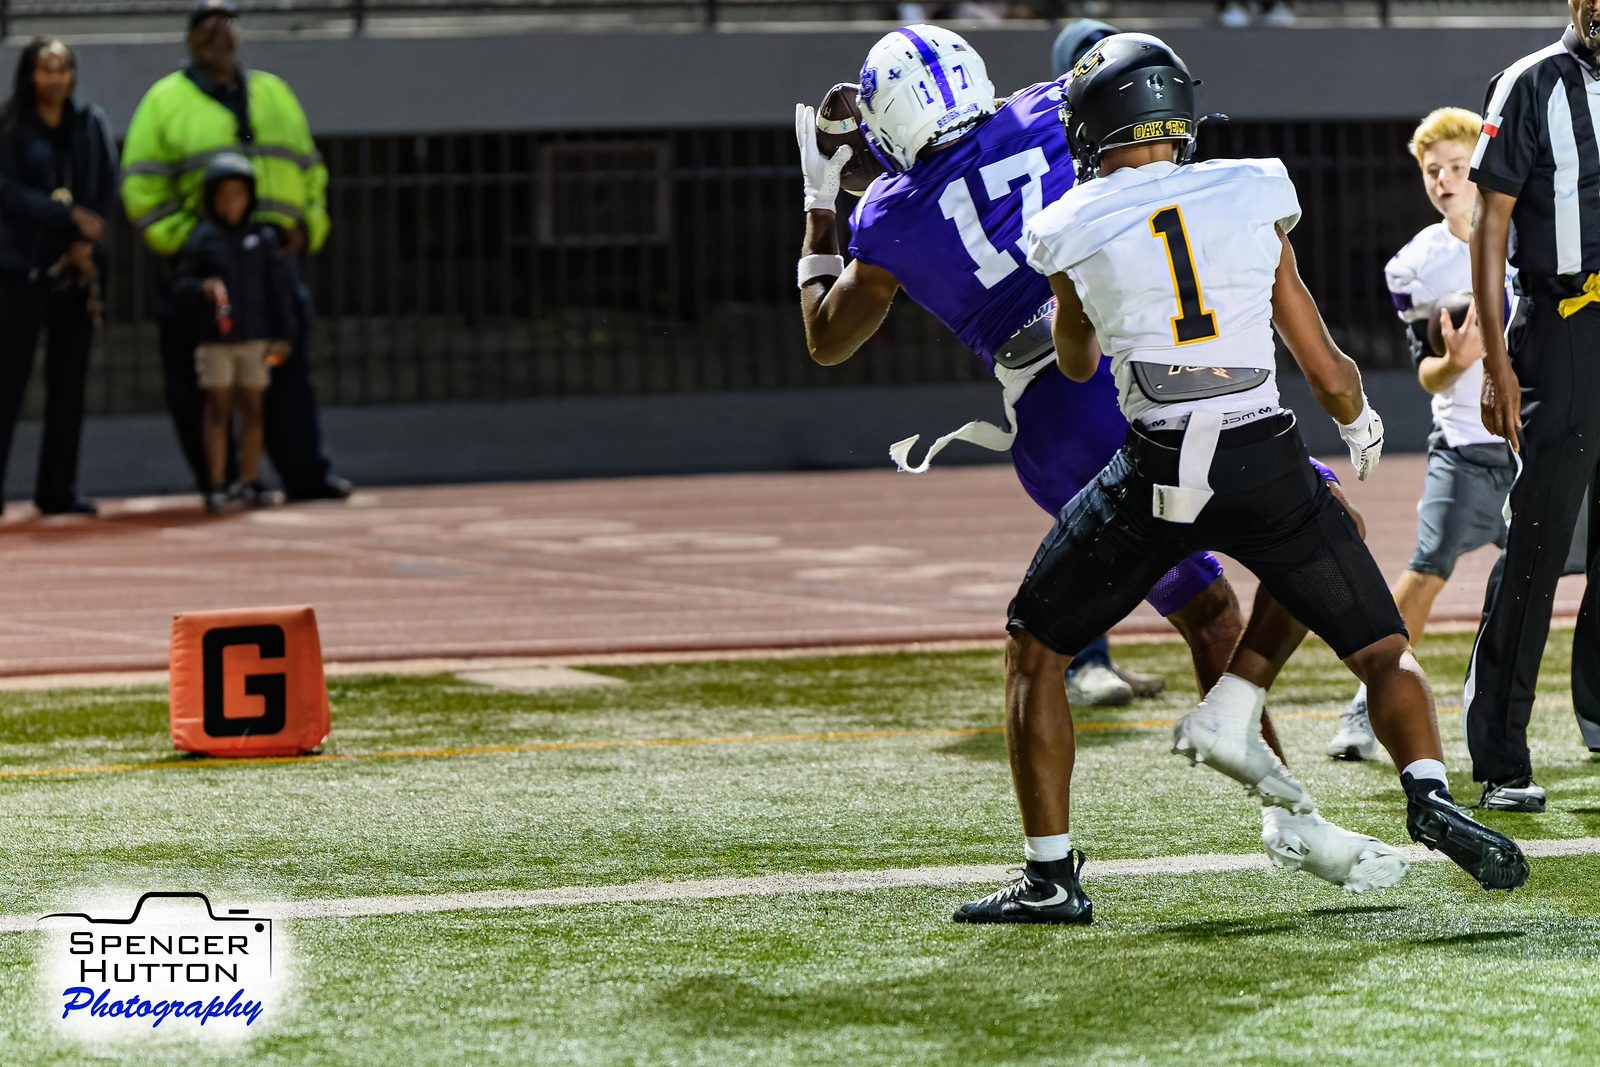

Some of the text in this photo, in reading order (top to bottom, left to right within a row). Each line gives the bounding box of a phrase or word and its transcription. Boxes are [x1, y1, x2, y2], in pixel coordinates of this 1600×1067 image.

[1133, 121, 1164, 141] OAK
[937, 146, 1051, 290] 17
[1147, 203, 1220, 347] 1
[202, 624, 286, 738] G
